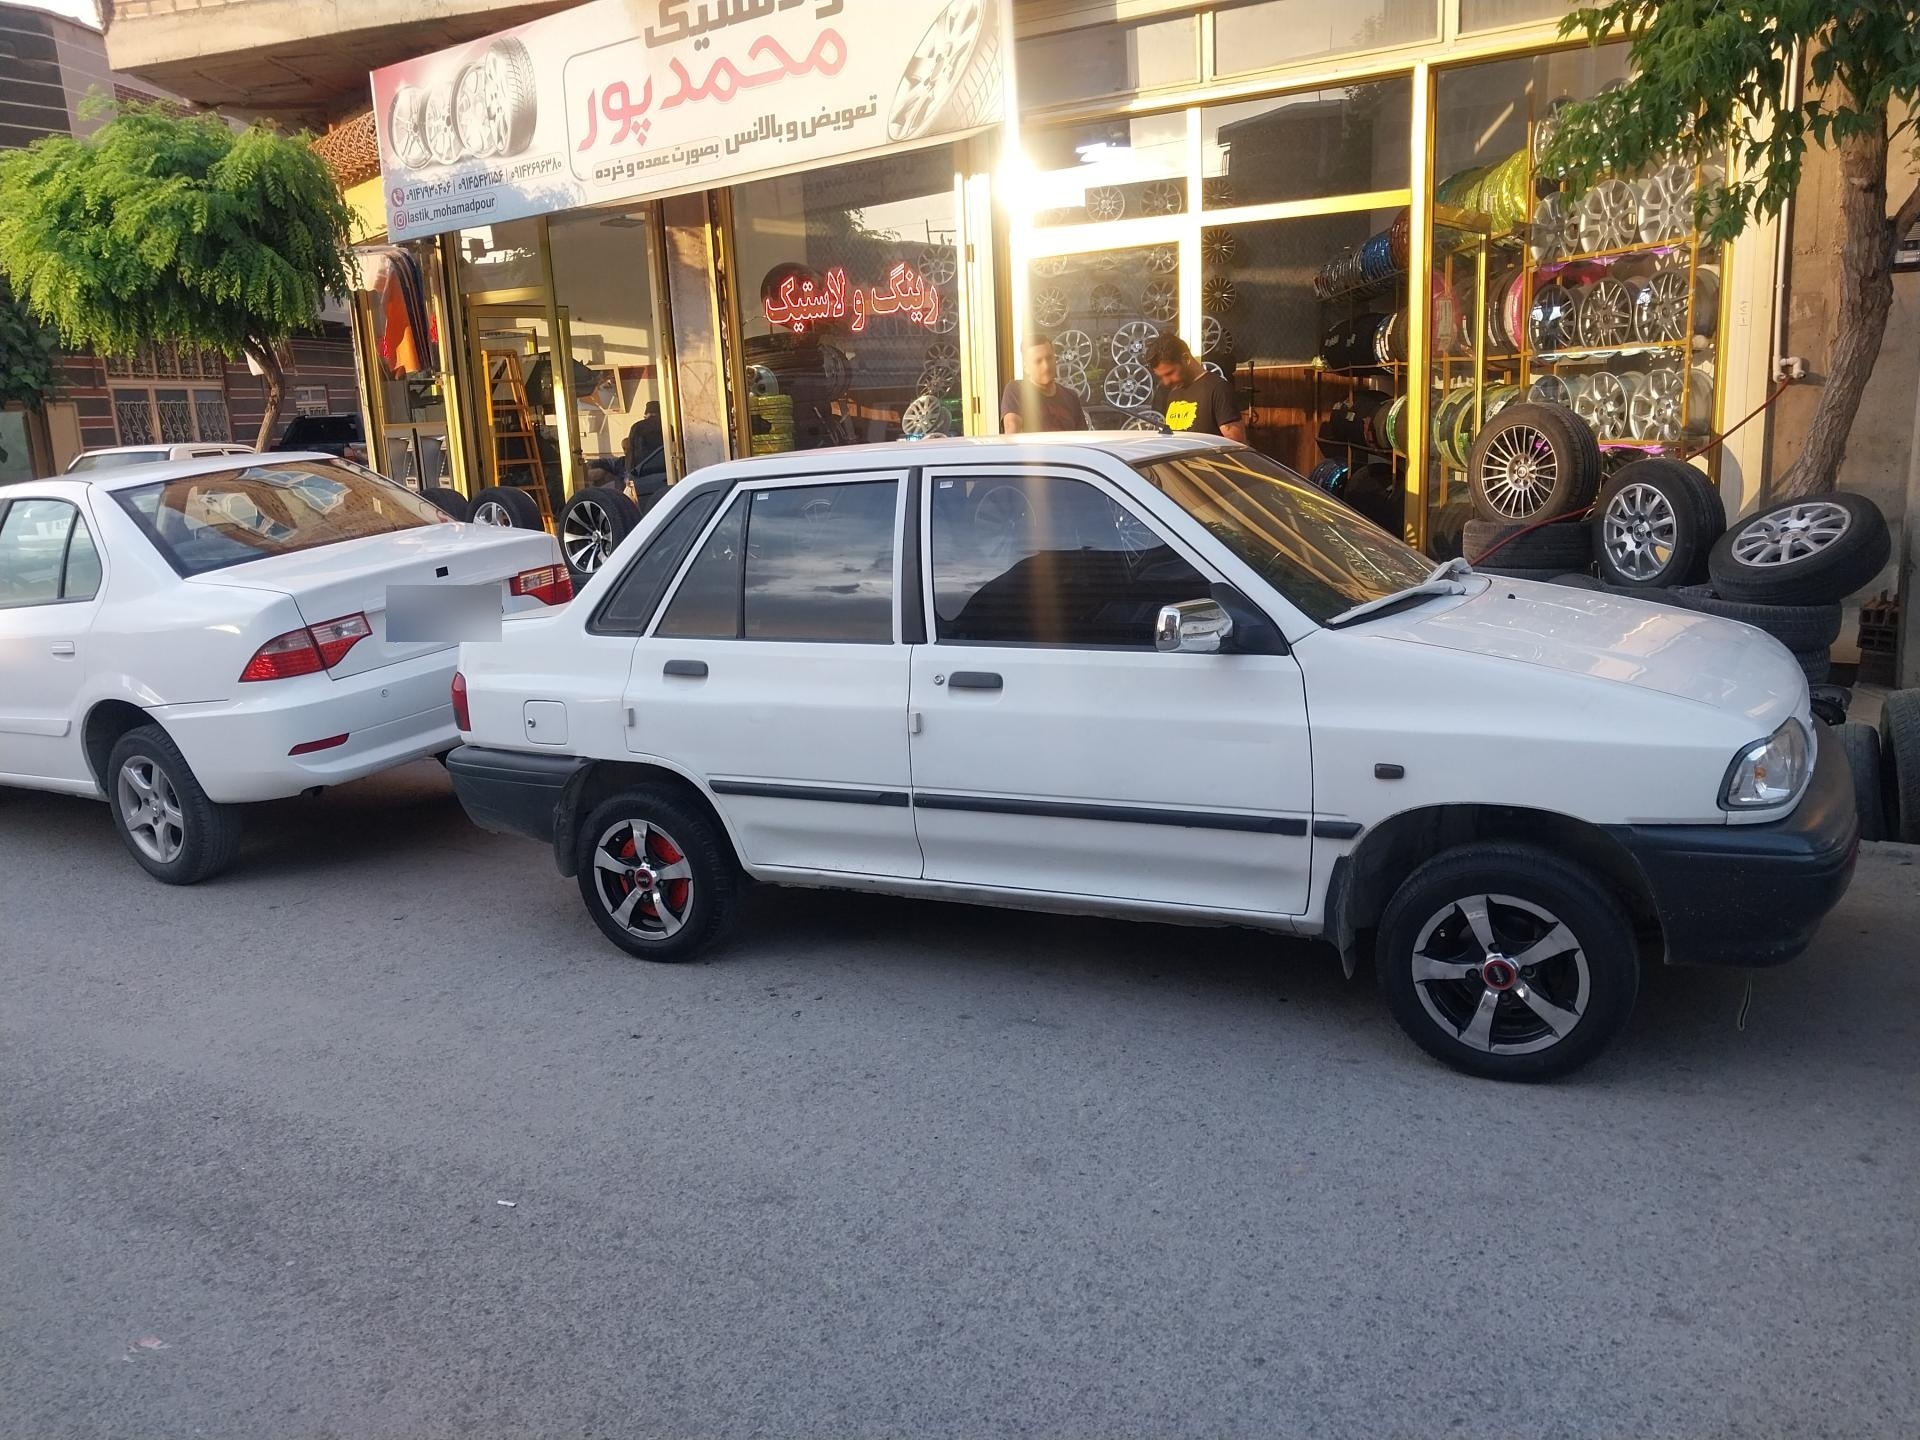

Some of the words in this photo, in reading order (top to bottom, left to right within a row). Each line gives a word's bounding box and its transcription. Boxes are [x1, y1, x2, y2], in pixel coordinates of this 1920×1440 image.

[801, 94, 878, 139] تعویض
[725, 113, 783, 155] بالانس
[786, 120, 798, 142] و
[636, 154, 670, 171] عمده
[671, 142, 720, 166] بصورت
[595, 159, 625, 181] خرده
[626, 161, 635, 178] و
[407, 197, 496, 223] lastik_mohamadpour
[764, 268, 846, 333] لاستیک
[871, 262, 939, 325] رینگ
[851, 288, 866, 332] و
